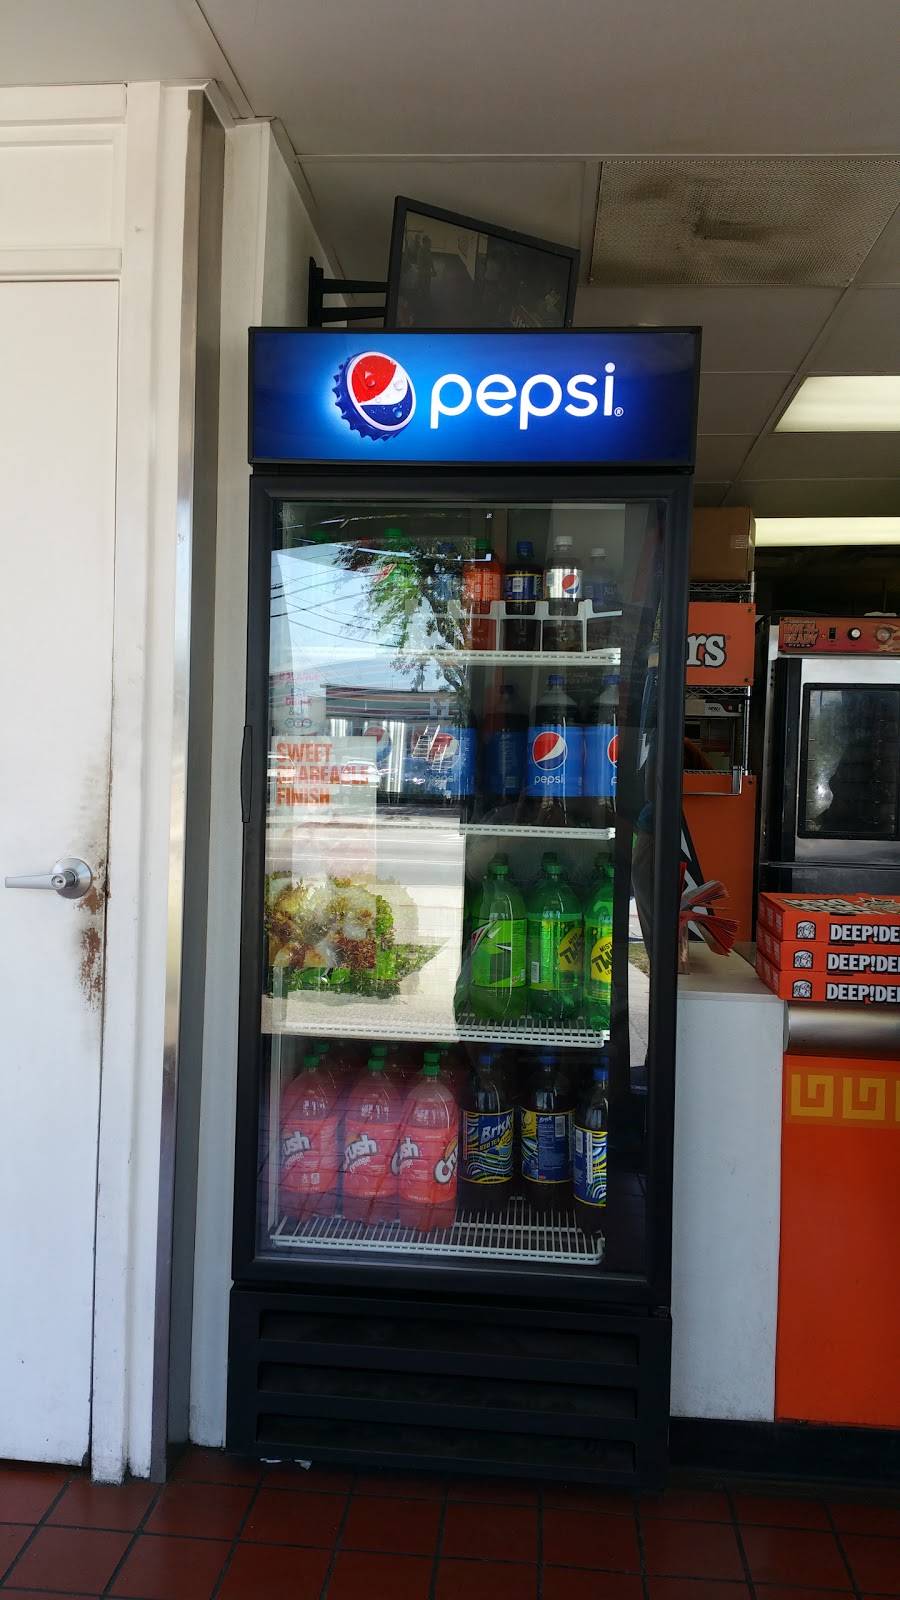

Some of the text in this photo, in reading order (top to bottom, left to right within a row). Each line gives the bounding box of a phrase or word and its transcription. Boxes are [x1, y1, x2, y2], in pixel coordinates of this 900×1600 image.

[430, 362, 616, 430] pepsi
[276, 743, 332, 762] SWEET
[534, 774, 564, 784] pepsi
[827, 953, 900, 972] DEEP!DE
[826, 983, 900, 1002] DEEP!DE
